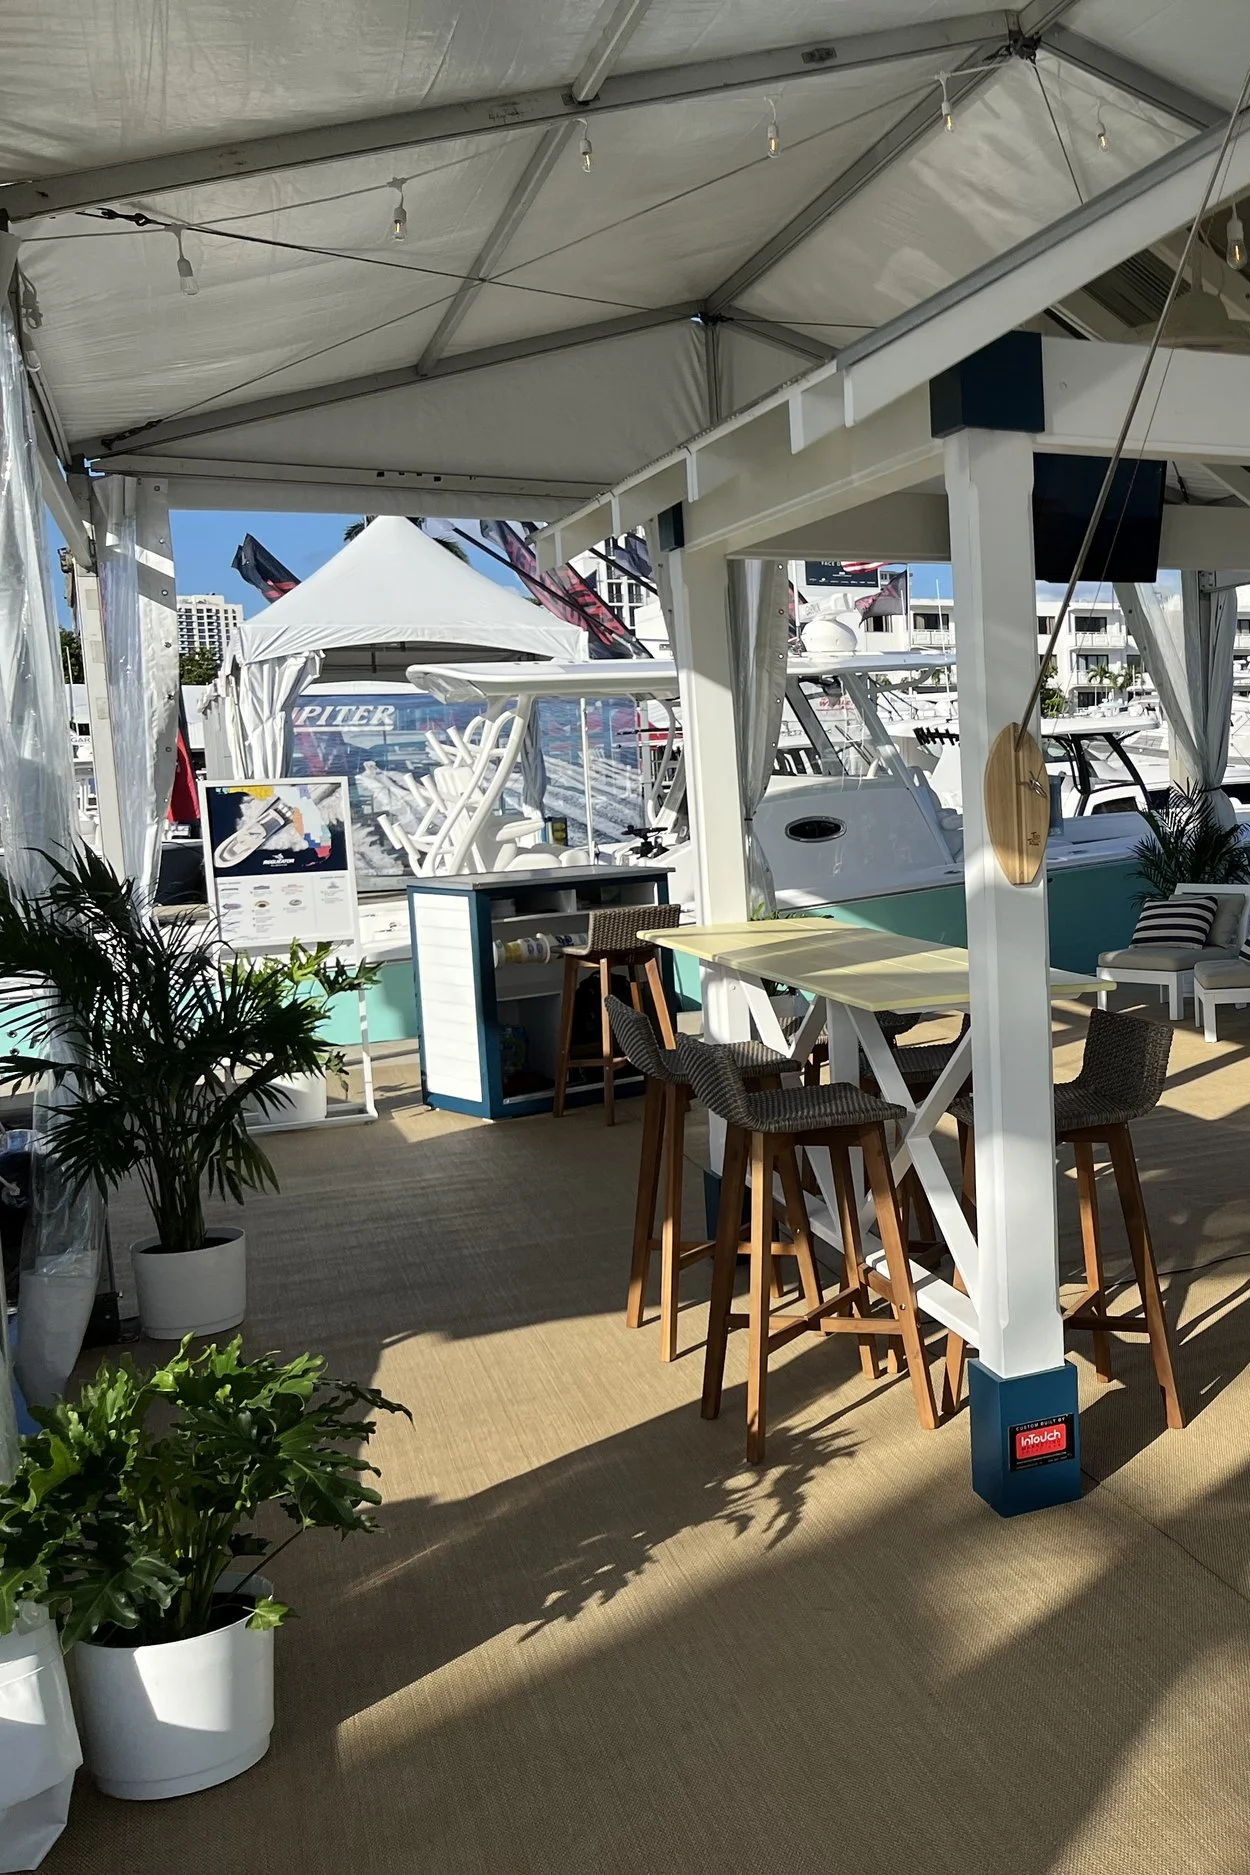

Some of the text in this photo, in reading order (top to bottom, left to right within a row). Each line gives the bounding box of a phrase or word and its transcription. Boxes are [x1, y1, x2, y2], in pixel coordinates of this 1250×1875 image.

[1015, 1422, 1039, 1432] CUSTOM
[1040, 1418, 1056, 1426] BUILT
[1021, 1429, 1061, 1447] InTouch
